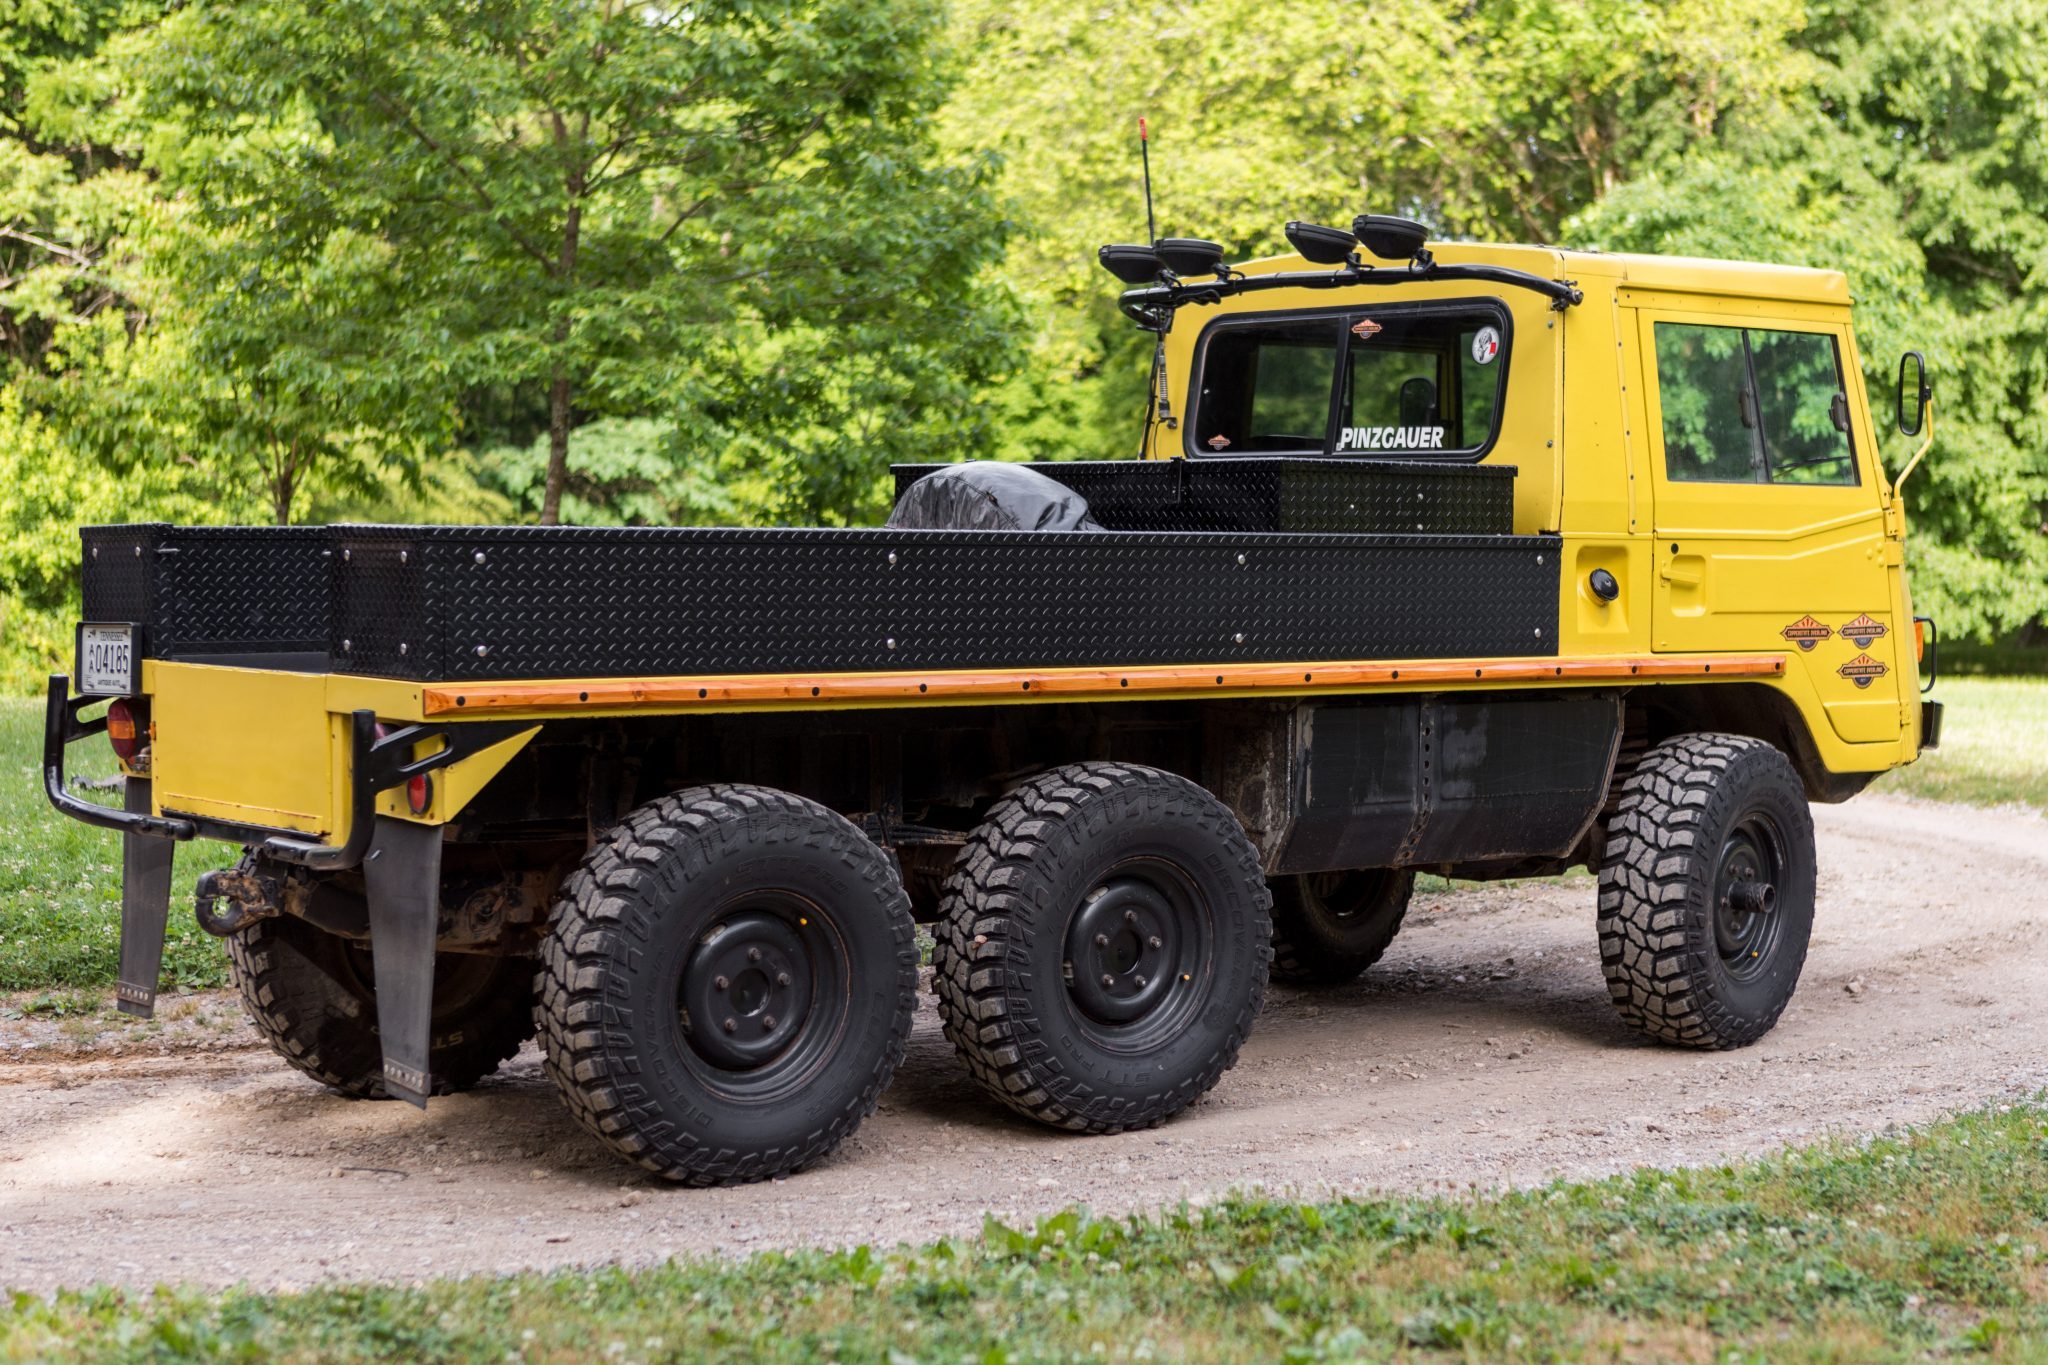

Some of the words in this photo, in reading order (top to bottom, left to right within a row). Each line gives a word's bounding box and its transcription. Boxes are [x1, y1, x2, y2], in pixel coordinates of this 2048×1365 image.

[1341, 427, 1445, 449] PINZGAUER
[100, 631, 124, 641] TENNESSEE
[96, 644, 129, 674] 04185
[736, 855, 800, 878] STT
[799, 862, 849, 896] PRO
[1061, 1034, 1102, 1072] PRO
[1100, 1066, 1153, 1089] STT
